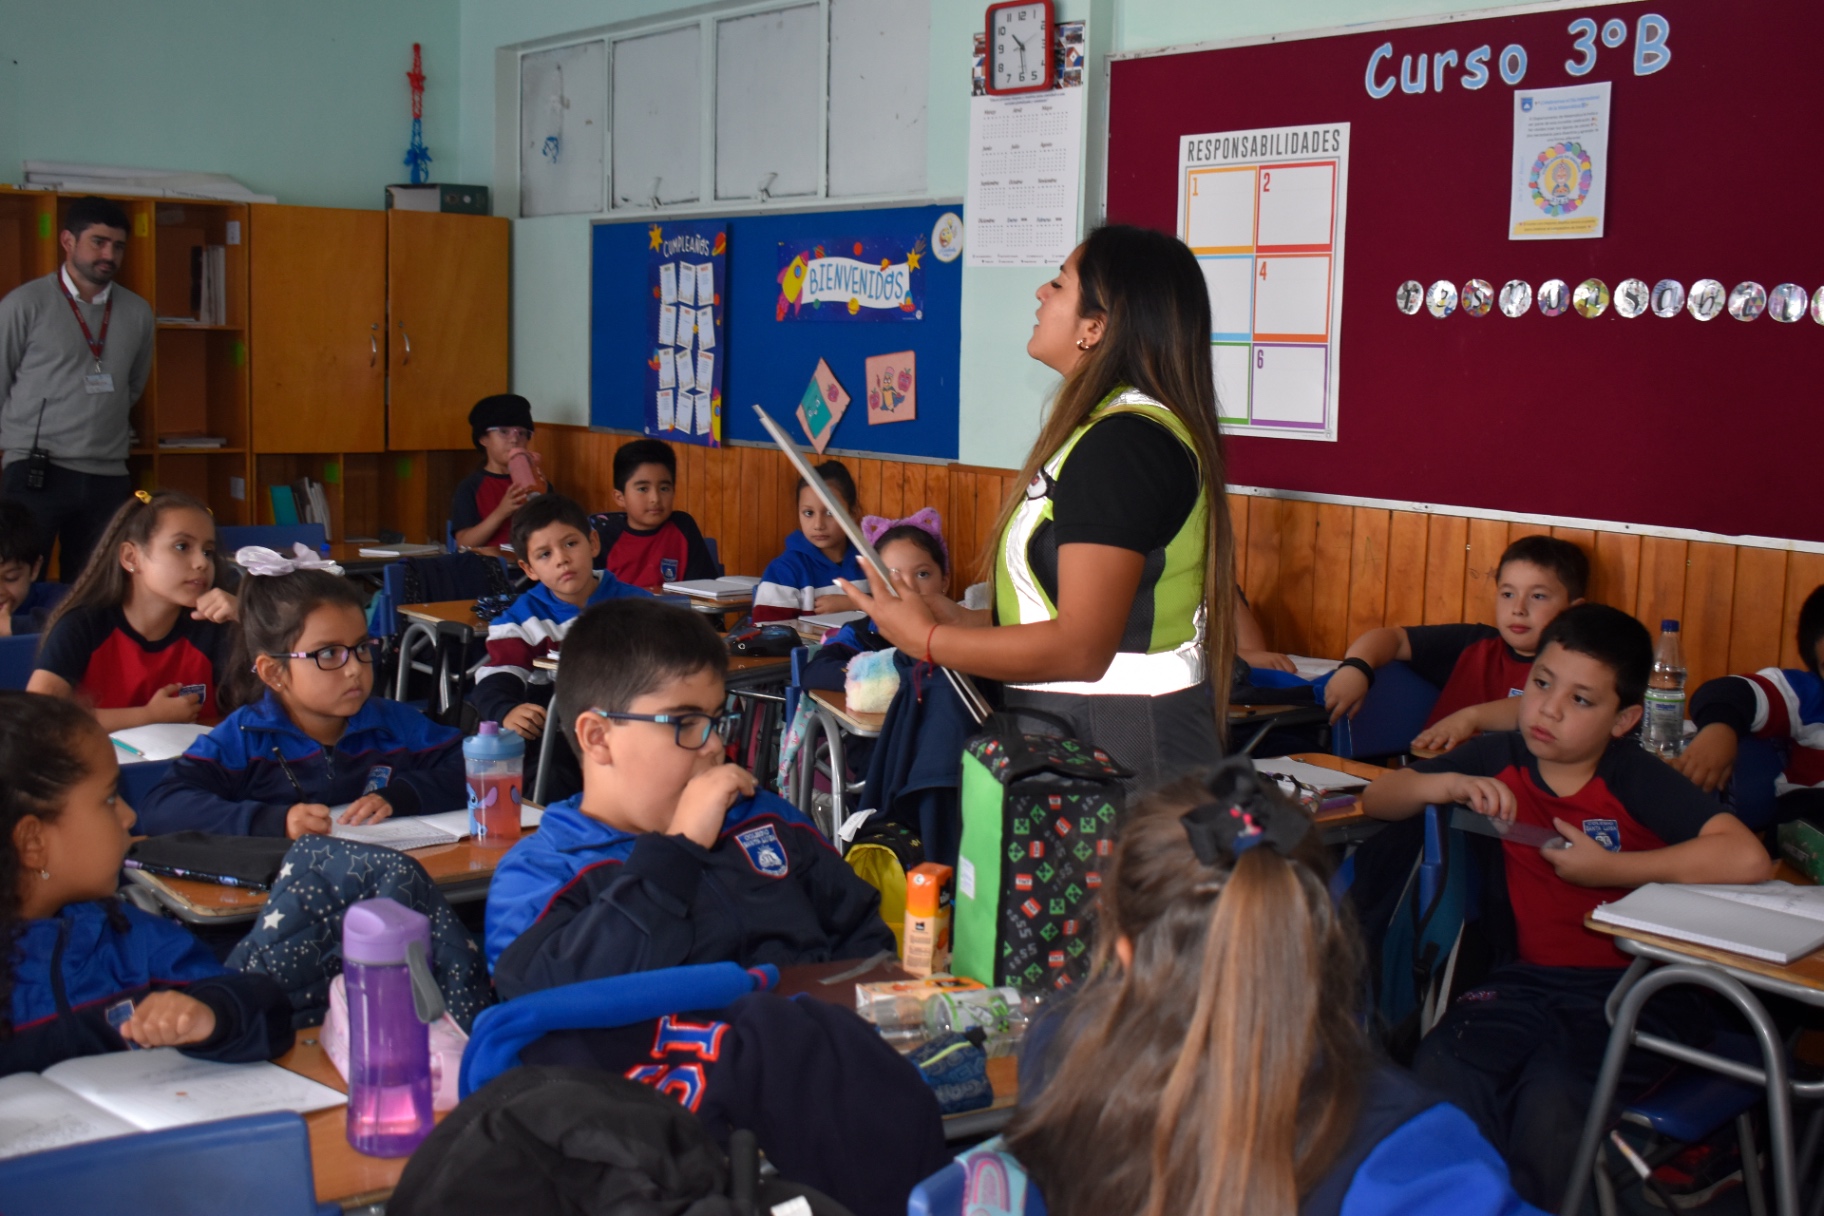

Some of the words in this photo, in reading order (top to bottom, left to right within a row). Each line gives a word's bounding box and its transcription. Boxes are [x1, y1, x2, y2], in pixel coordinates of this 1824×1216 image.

[1006, 13, 1012, 22] 11
[1018, 11, 1026, 21] 12
[998, 26, 1006, 36] 10
[998, 44, 1004, 54] 9
[998, 63, 1004, 72] 8
[1365, 42, 1528, 99] Curso
[1006, 74, 1012, 84] 7
[1019, 72, 1026, 82] 6
[1031, 70, 1038, 80] 5
[1187, 128, 1341, 162] RESPONSABILIDADES
[1192, 177, 1198, 196] 1
[1263, 172, 1270, 192] 2
[663, 233, 710, 258] CUMPLEAÑOS
[1259, 261, 1267, 281] 4
[809, 262, 904, 301] BIENVENIDOS
[1256, 348, 1264, 369] 6
